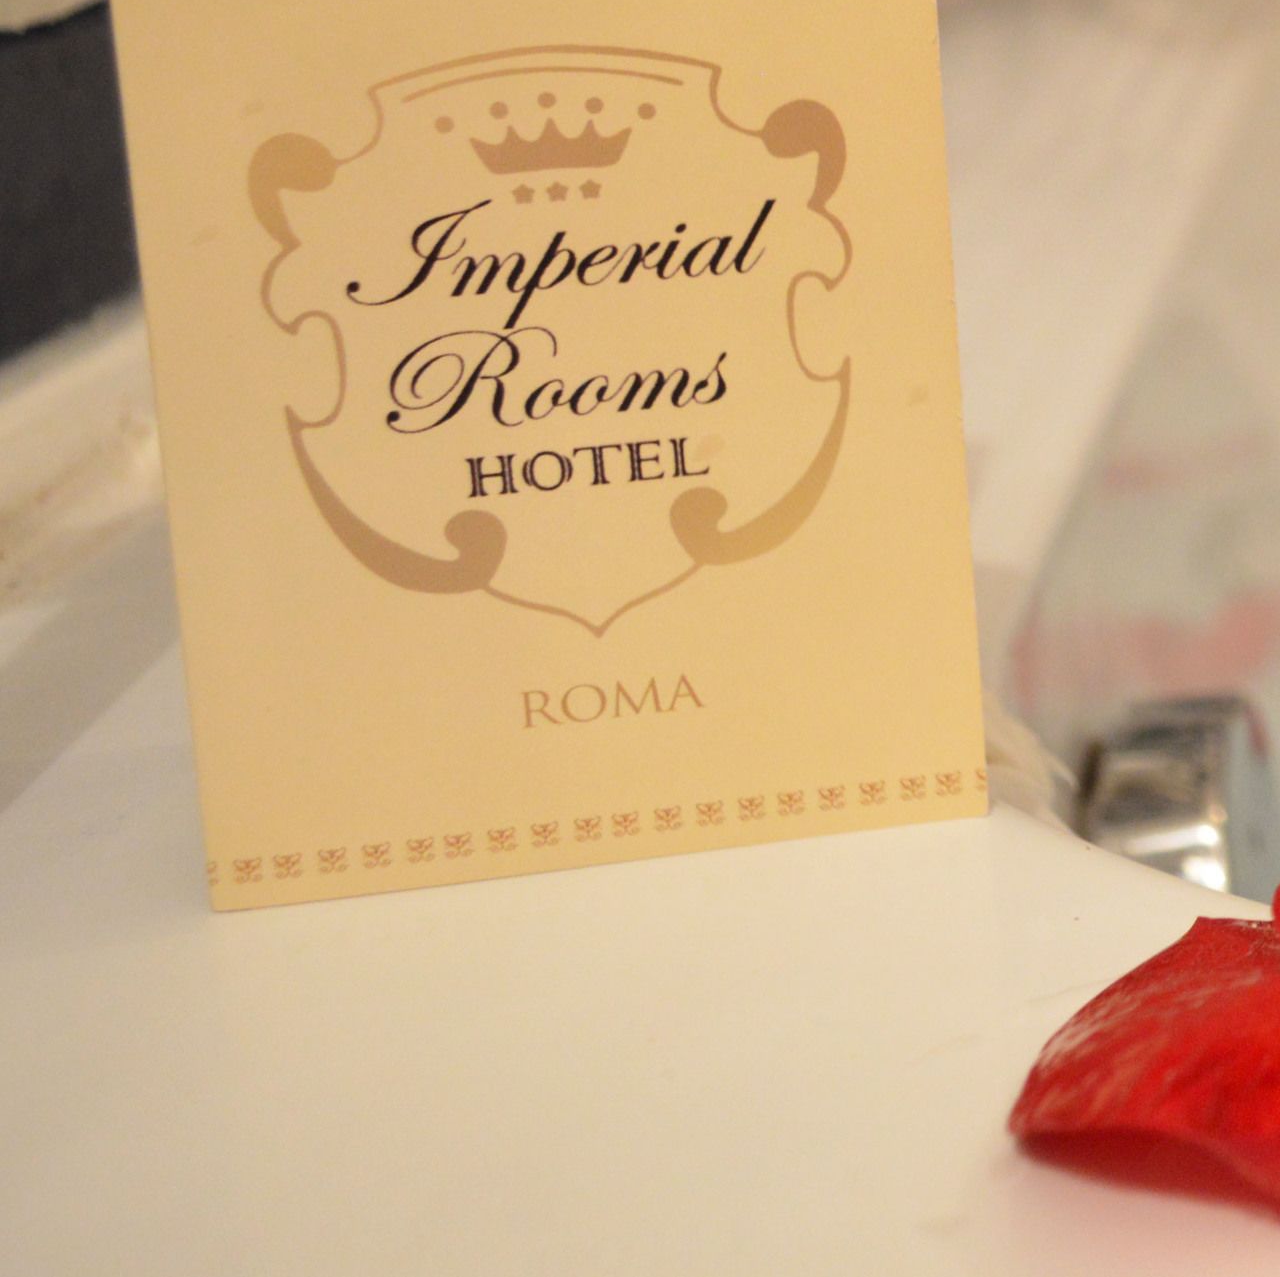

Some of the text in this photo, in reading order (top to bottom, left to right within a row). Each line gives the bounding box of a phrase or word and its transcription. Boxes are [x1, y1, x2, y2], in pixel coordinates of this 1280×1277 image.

[345, 199, 777, 330] Imperial
[386, 326, 727, 434] Rooms
[464, 437, 711, 499] HOTEL
[520, 673, 706, 729] ROMA
